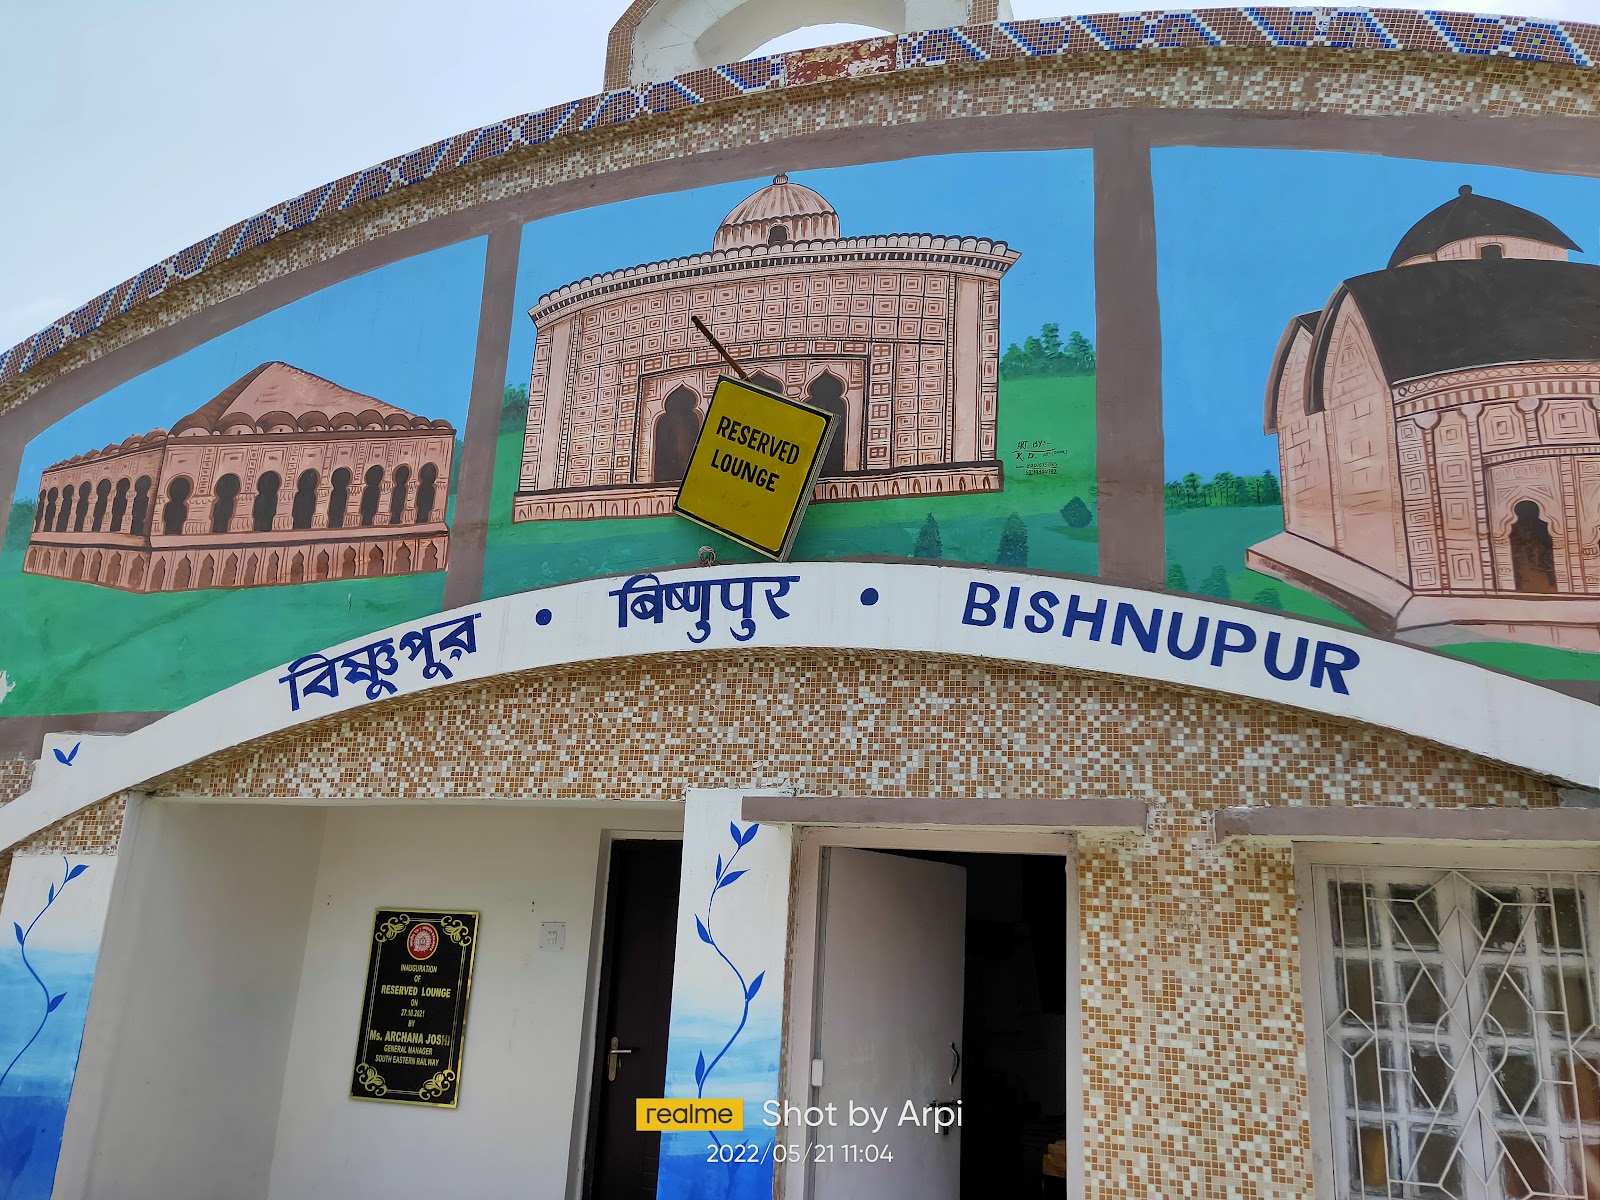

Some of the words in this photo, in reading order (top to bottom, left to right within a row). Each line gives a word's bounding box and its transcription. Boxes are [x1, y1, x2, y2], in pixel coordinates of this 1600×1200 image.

[716, 415, 800, 465] RESERVED
[710, 448, 780, 492] LOUNGE
[609, 573, 800, 643] बिष्णुपुर
[961, 581, 1361, 696] BISHNUPUR
[279, 612, 482, 711] বিষ্ণুপুর
[400, 963, 438, 973] INAUGURATION
[413, 974, 422, 982] OF
[381, 984, 418, 996] RESERVED
[421, 986, 452, 998] LOUNGE
[410, 998, 419, 1006] ON
[407, 1019, 416, 1027] BY
[369, 1029, 383, 1041] Ms.
[384, 1030, 424, 1044] ARCHANA
[425, 1033, 451, 1046] JOSHI
[383, 1044, 408, 1054] GENERAL
[407, 1046, 433, 1055] MANAGER
[375, 1054, 393, 1064] SOUTH
[392, 1055, 416, 1065] EASTERN
[415, 1057, 440, 1067] RAILWAY
